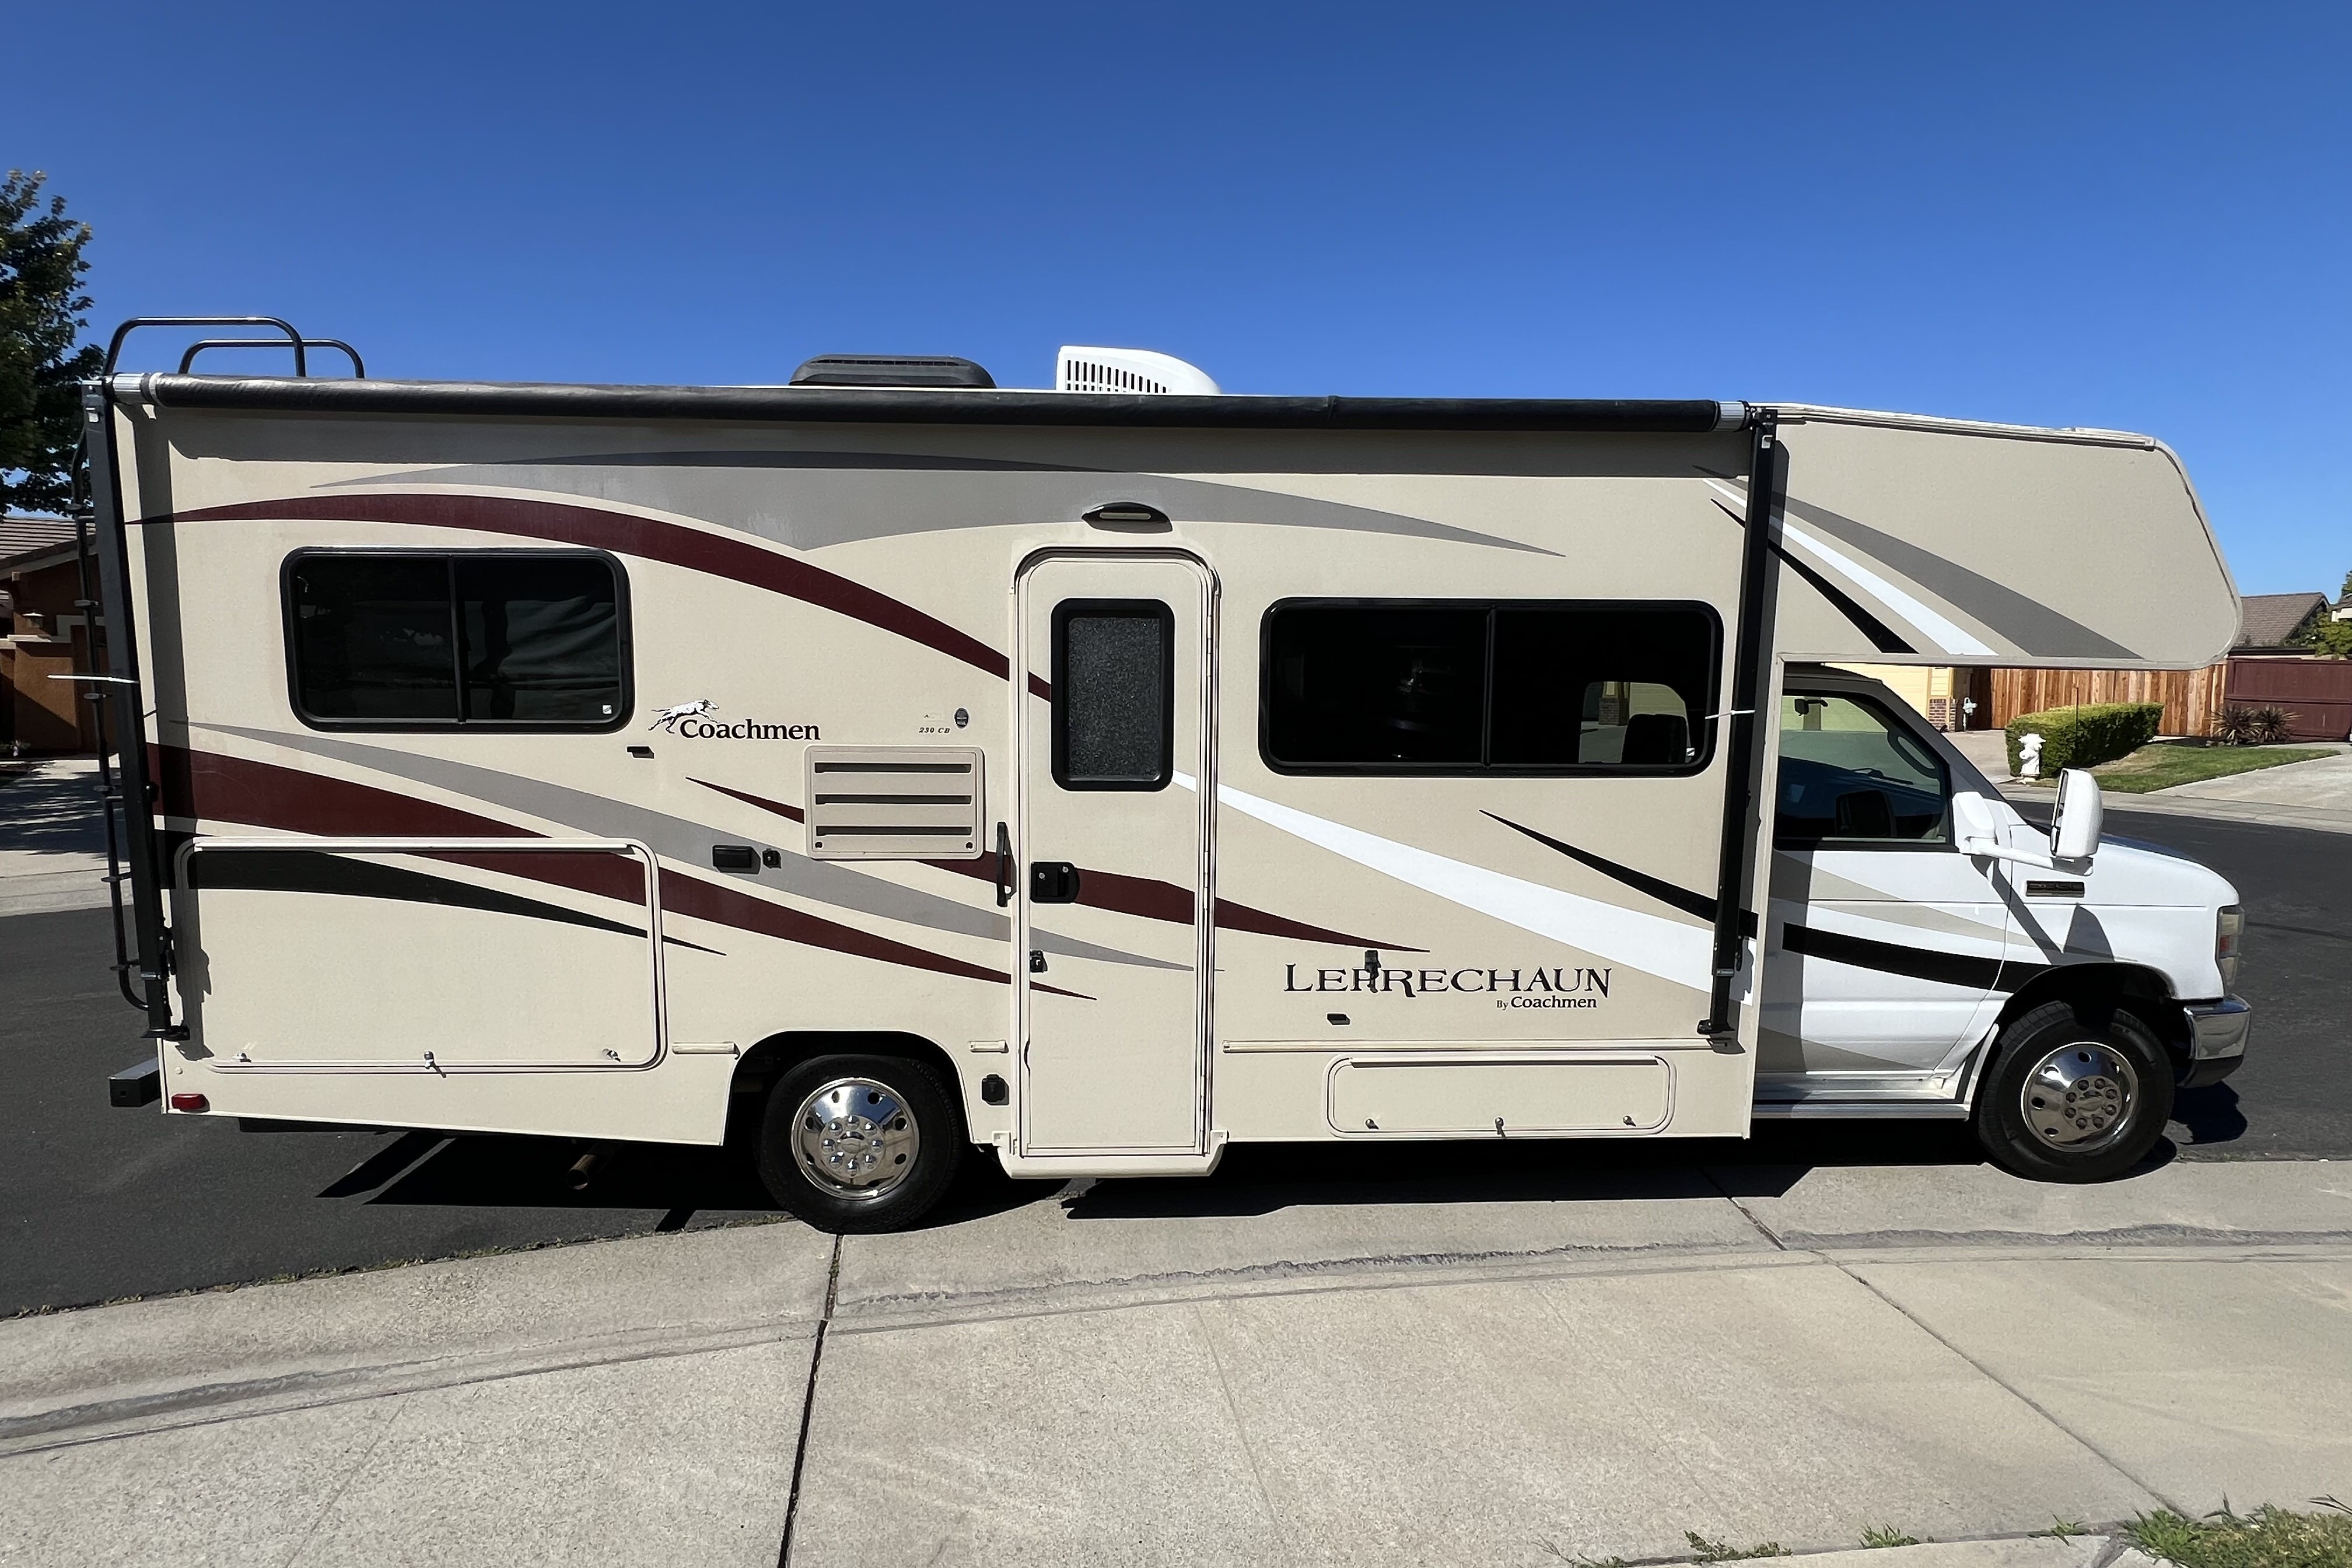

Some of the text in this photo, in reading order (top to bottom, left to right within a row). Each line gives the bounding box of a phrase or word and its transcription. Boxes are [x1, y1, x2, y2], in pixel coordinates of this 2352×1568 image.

[680, 719, 821, 740] Coachmen
[1496, 995, 1597, 1011] By Coachmen
